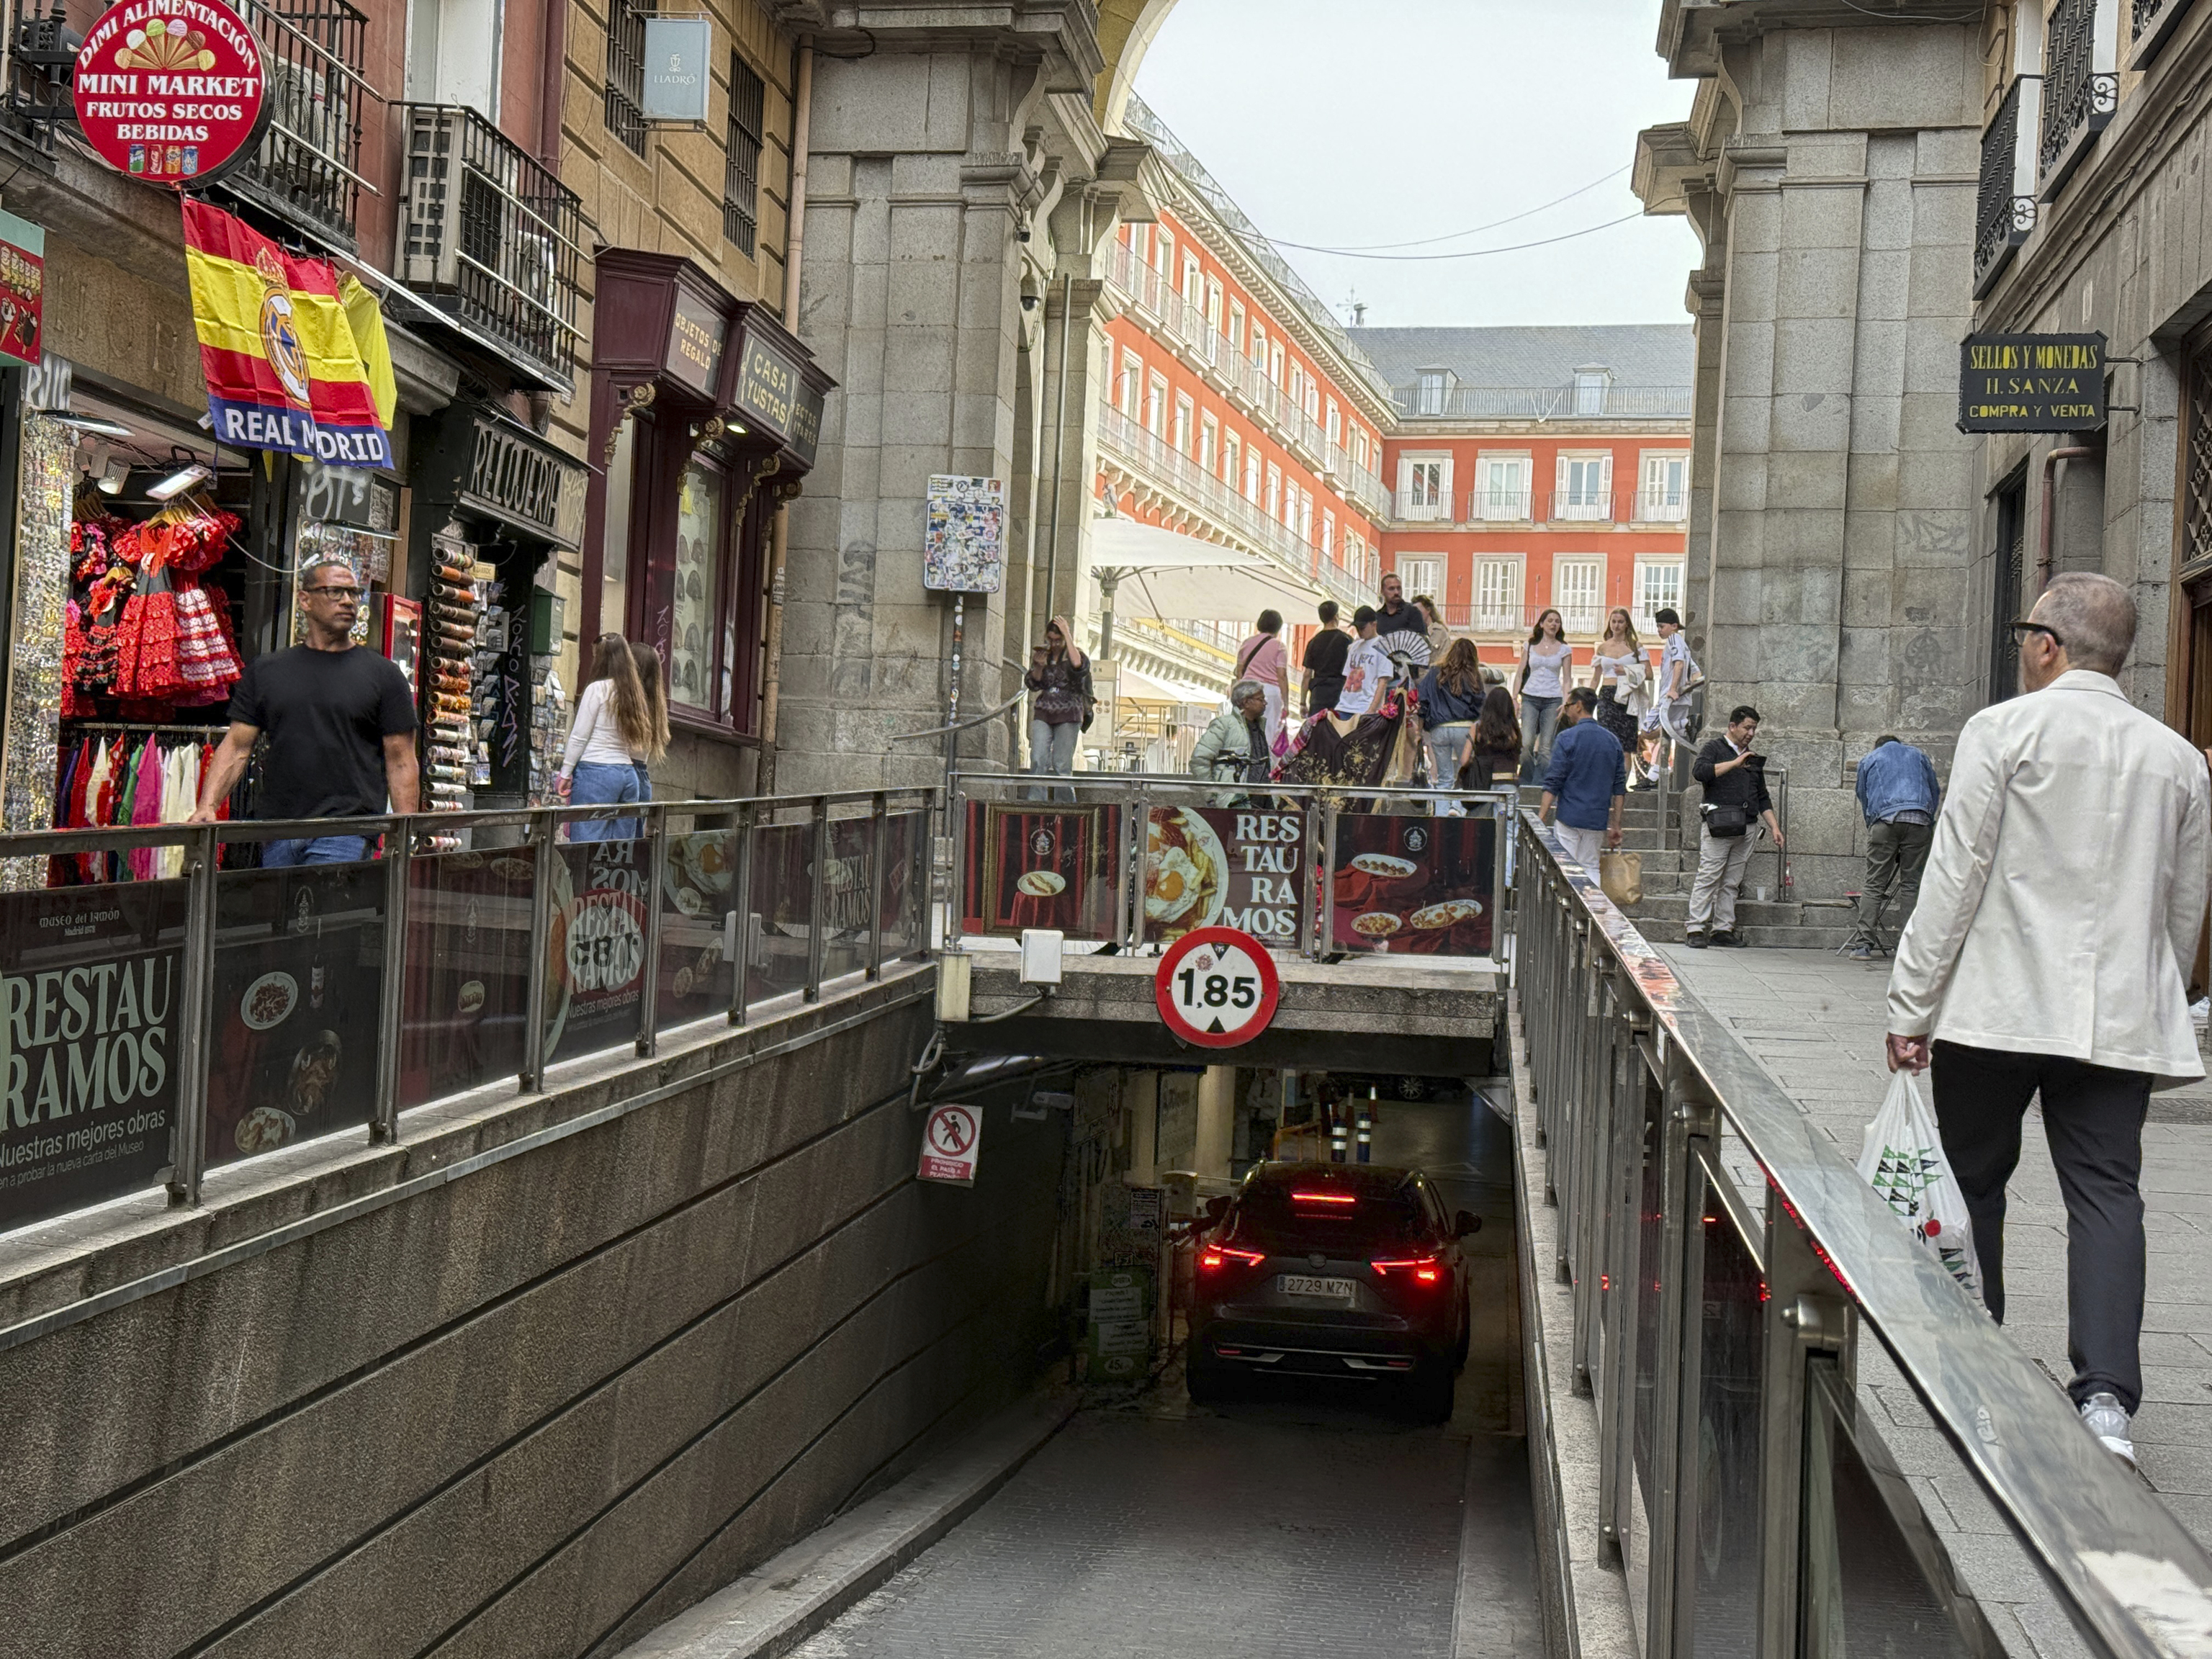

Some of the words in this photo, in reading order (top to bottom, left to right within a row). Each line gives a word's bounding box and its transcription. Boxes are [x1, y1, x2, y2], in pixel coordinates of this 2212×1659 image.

[78, 17, 120, 70] DIMI
[122, 0, 257, 73] ALIMENTACIÓN
[78, 74, 138, 94] MINI
[147, 75, 259, 97] MARKET
[86, 102, 167, 119] FRUTOS
[172, 103, 243, 121] SECOS
[117, 124, 209, 141] BEBIDAS
[675, 313, 709, 348] OBJETOS
[712, 339, 722, 356] DE
[680, 338, 711, 371] REGALO
[1971, 345, 2019, 369] SELLOS
[2023, 346, 2032, 369] Y
[2035, 345, 2098, 369] MONEDAS
[755, 353, 787, 395] CASA
[1986, 378, 2004, 395] H.
[2008, 377, 2080, 395] SANZA
[747, 377, 786, 424] YUSTAS
[1969, 405, 2028, 418] COMPRA
[2033, 405, 2043, 417] Y
[2051, 405, 2095, 418] VENTA
[225, 409, 296, 446] REAL
[303, 430, 384, 462] MDRID
[1236, 815, 1300, 842] RES
[1241, 846, 1298, 873] TAU
[1251, 878, 1298, 904] RA
[1224, 908, 1296, 935] MOS
[2, 956, 173, 1050] RESTAU
[566, 999, 595, 1020] Nuestras
[597, 993, 621, 1013] mejores
[622, 989, 639, 1005] obras
[1178, 968, 1255, 1010] 1,85
[1, 1026, 166, 1131] RAMOS
[66, 1120, 125, 1151] mejores
[127, 1109, 166, 1136] obras
[17, 1166, 47, 1189] probar
[47, 1161, 55, 1176] la
[56, 1157, 81, 1174] nueva
[82, 1151, 103, 1166] carta
[104, 1146, 117, 1161] del
[117, 1139, 144, 1157] Museo
[1287, 1278, 1321, 1292] 2729
[1327, 1281, 1352, 1295] MZN
